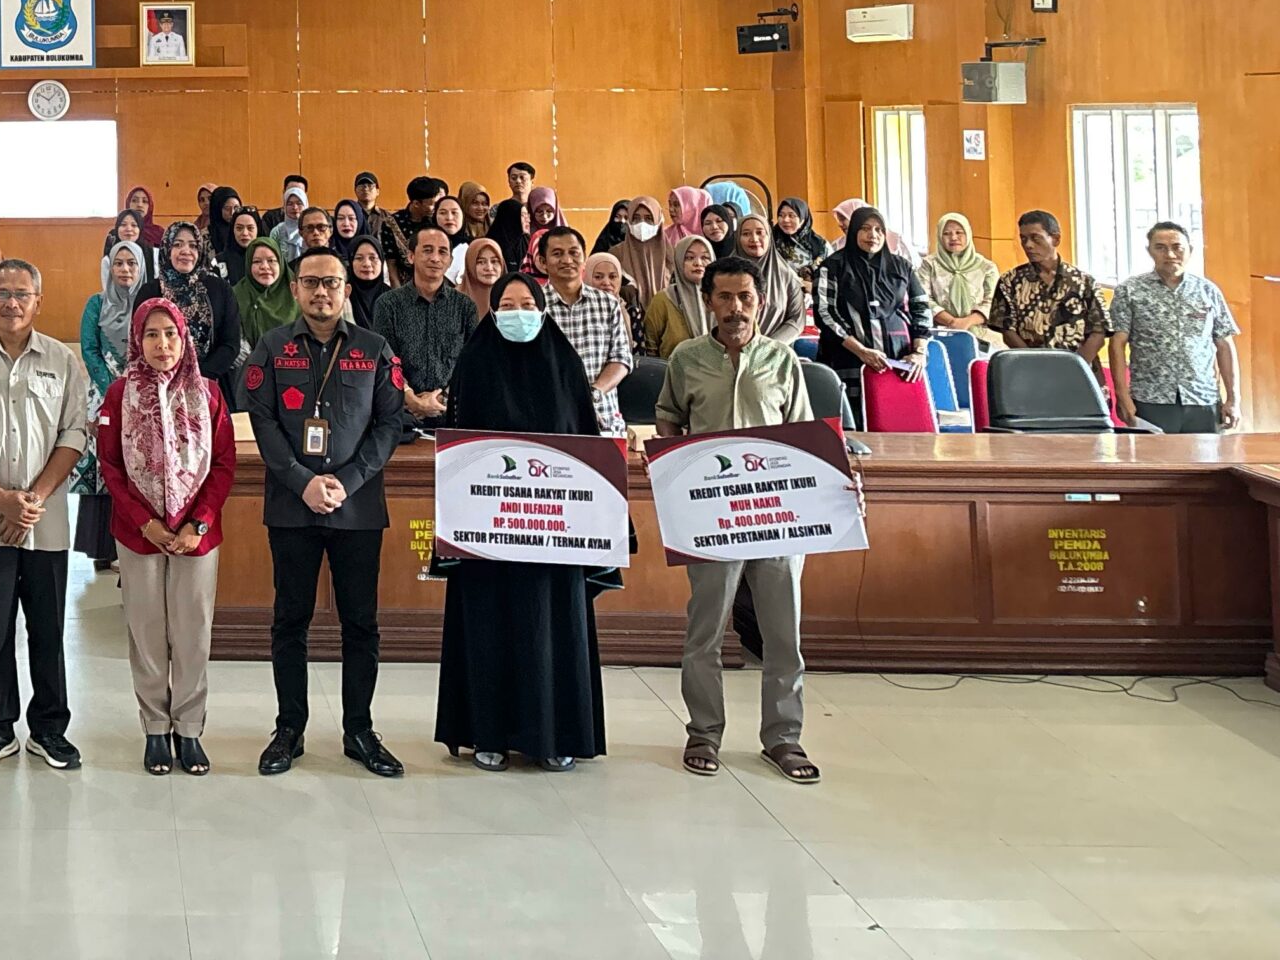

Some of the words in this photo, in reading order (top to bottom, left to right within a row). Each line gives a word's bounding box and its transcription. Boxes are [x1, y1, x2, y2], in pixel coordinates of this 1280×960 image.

[470, 485, 501, 497] KREDIT
[503, 487, 532, 498] USAHA
[534, 488, 567, 500] RAKYAT
[689, 486, 722, 500] KREDIT
[722, 482, 754, 497] USAHA
[756, 479, 788, 493] RAKYAT
[500, 502, 521, 513] ANDI
[523, 502, 563, 516] ULFAIZAH
[730, 499, 752, 512] MUH
[752, 496, 782, 509] NAKIR
[494, 517, 506, 528] RP.
[718, 518, 733, 530] Rp.
[453, 530, 487, 544] SEKTOR
[488, 532, 544, 547] PETERNAKAN
[552, 536, 586, 549] TERNAK
[587, 538, 612, 550] AYAM
[693, 533, 729, 548] SEKTOR
[730, 528, 780, 545] PERTANIAN
[788, 523, 832, 538] ALSINTAN
[1048, 528, 1107, 539] INVENTARIS
